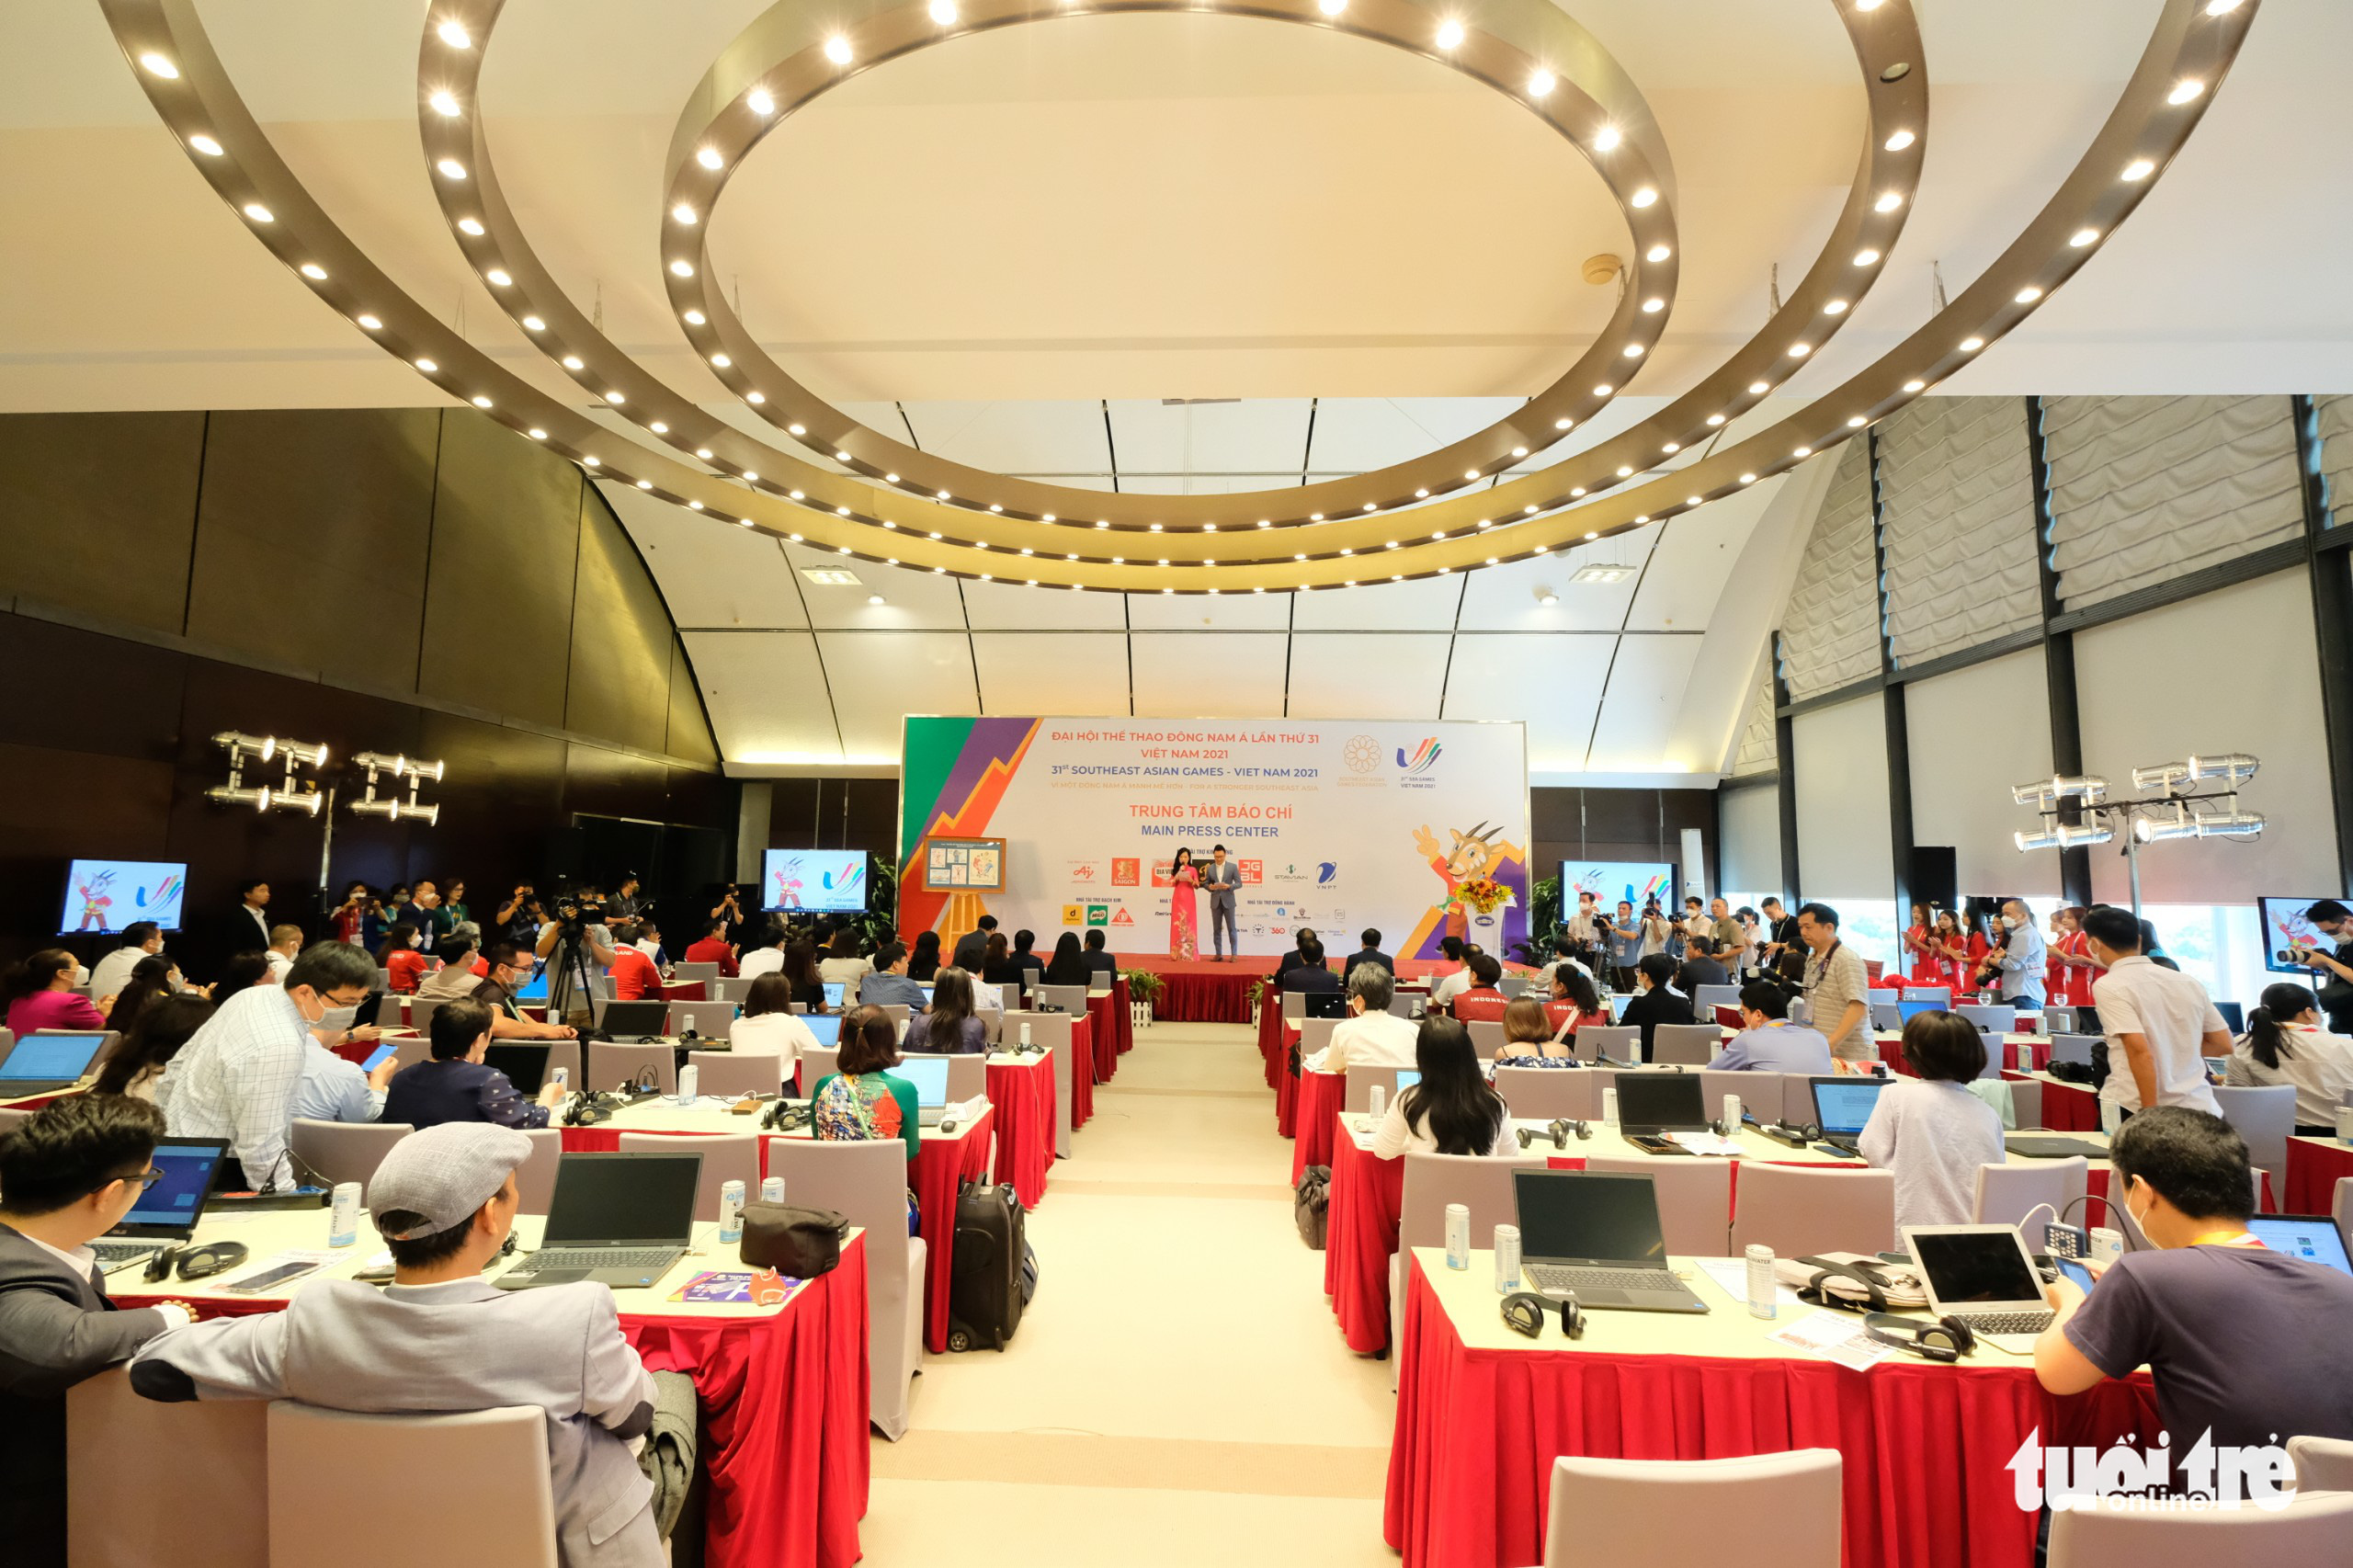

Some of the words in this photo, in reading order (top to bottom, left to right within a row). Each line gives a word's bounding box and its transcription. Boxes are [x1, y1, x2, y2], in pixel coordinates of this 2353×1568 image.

[1051, 732, 1073, 744] ĐẠI
[1076, 730, 1098, 744] HỘI
[1130, 732, 1164, 742] THAO
[1166, 731, 1204, 743] ĐÔNG
[1207, 733, 1238, 743] NAM
[1239, 731, 1248, 743] Á
[1279, 732, 1306, 744] THỨ
[1307, 734, 1319, 744] 31
[1141, 747, 1168, 761] VIỆT
[1171, 749, 1199, 758] NAM
[1202, 749, 1229, 759] 2021
[1051, 764, 1069, 775] 31st
[1072, 766, 1141, 776] SOUTHEAST
[1143, 767, 1179, 776] ASIAN
[1182, 767, 1224, 777] GAMES
[1233, 767, 1260, 777] VIET
[1263, 767, 1290, 778] NAM
[1293, 768, 1318, 778] 2021
[1130, 805, 1184, 818] TRUNG
[1188, 802, 1222, 818] TÂM
[1227, 802, 1261, 819] BÁO
[1266, 803, 1292, 819] CHÍ
[1142, 825, 1174, 835] MAIN
[1178, 825, 1222, 836] PRESS
[1225, 826, 1279, 837] CENTER
